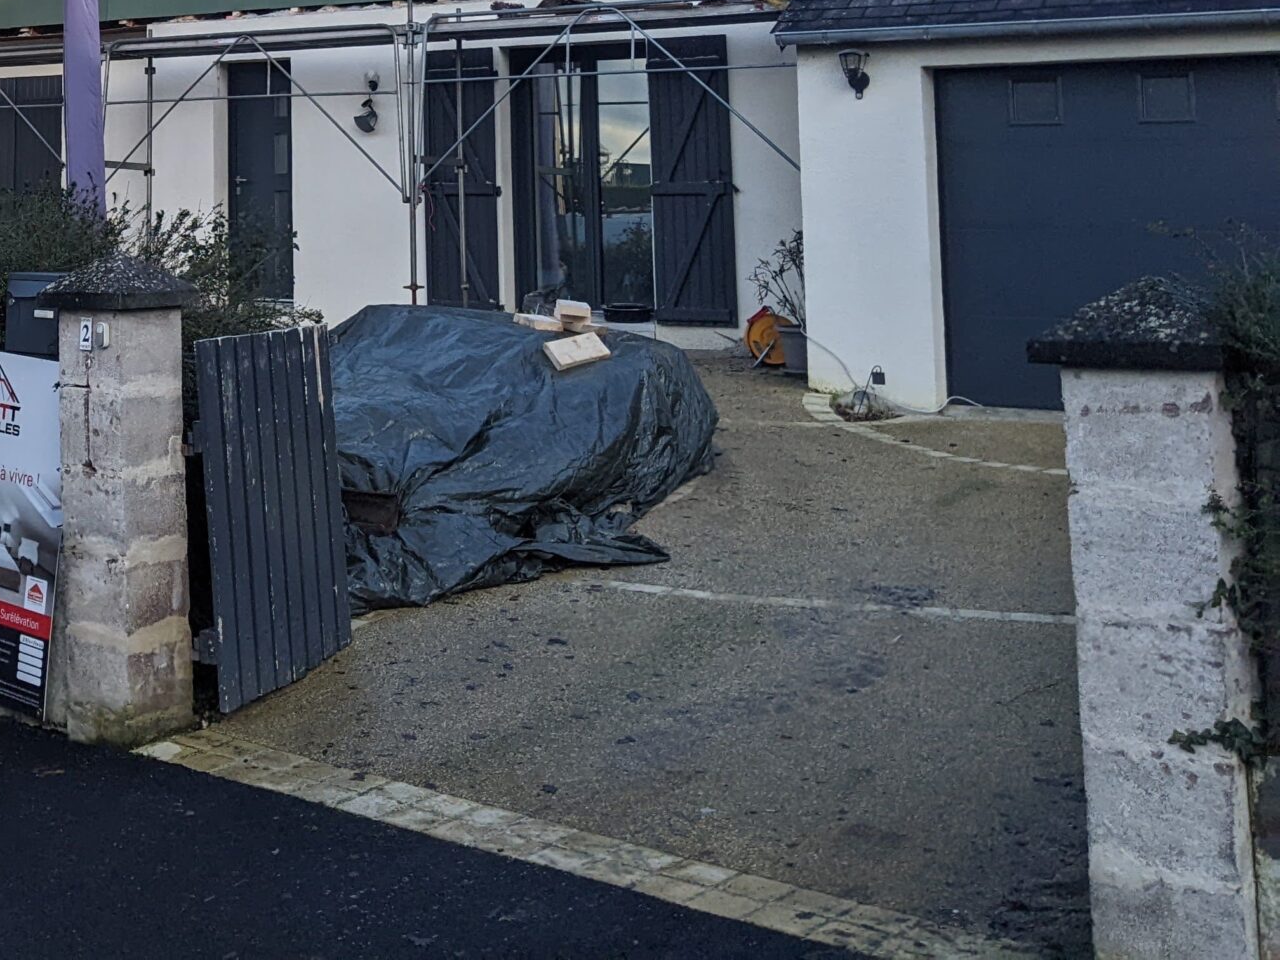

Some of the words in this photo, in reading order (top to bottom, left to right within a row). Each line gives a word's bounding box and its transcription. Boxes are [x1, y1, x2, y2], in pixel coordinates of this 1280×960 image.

[81, 324, 90, 343] 2
[0, 465, 6, 480] à
[9, 468, 34, 487] vivre
[0, 609, 39, 631] Surélévation
